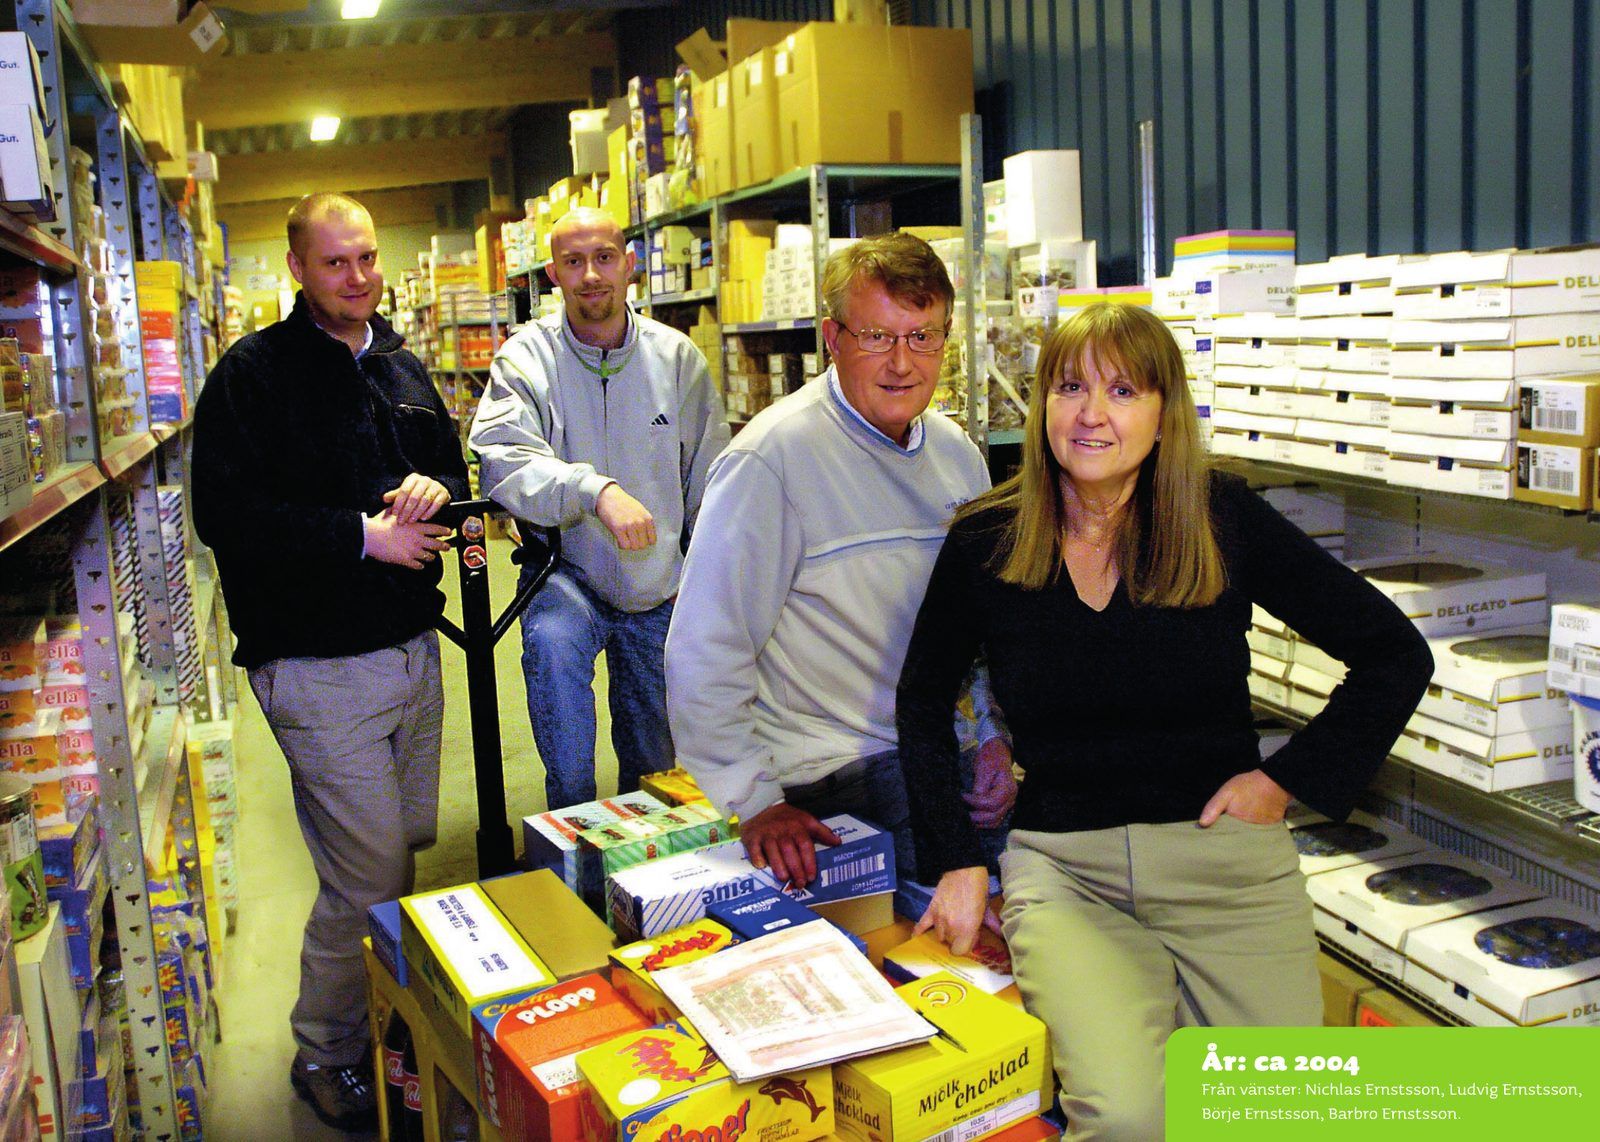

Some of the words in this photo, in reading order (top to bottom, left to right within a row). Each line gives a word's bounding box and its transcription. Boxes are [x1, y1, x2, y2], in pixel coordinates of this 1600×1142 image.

[1266, 285, 1298, 295] DELIC
[1563, 275, 1600, 289] DEL
[1565, 334, 1600, 348] DEL
[1437, 599, 1507, 618] DELICATO
[1543, 743, 1573, 759] DEL
[515, 987, 597, 1025] PLOPP
[954, 1046, 1030, 1110] choklad
[918, 1079, 961, 1117] Mjölk
[835, 1098, 881, 1131] hoklad
